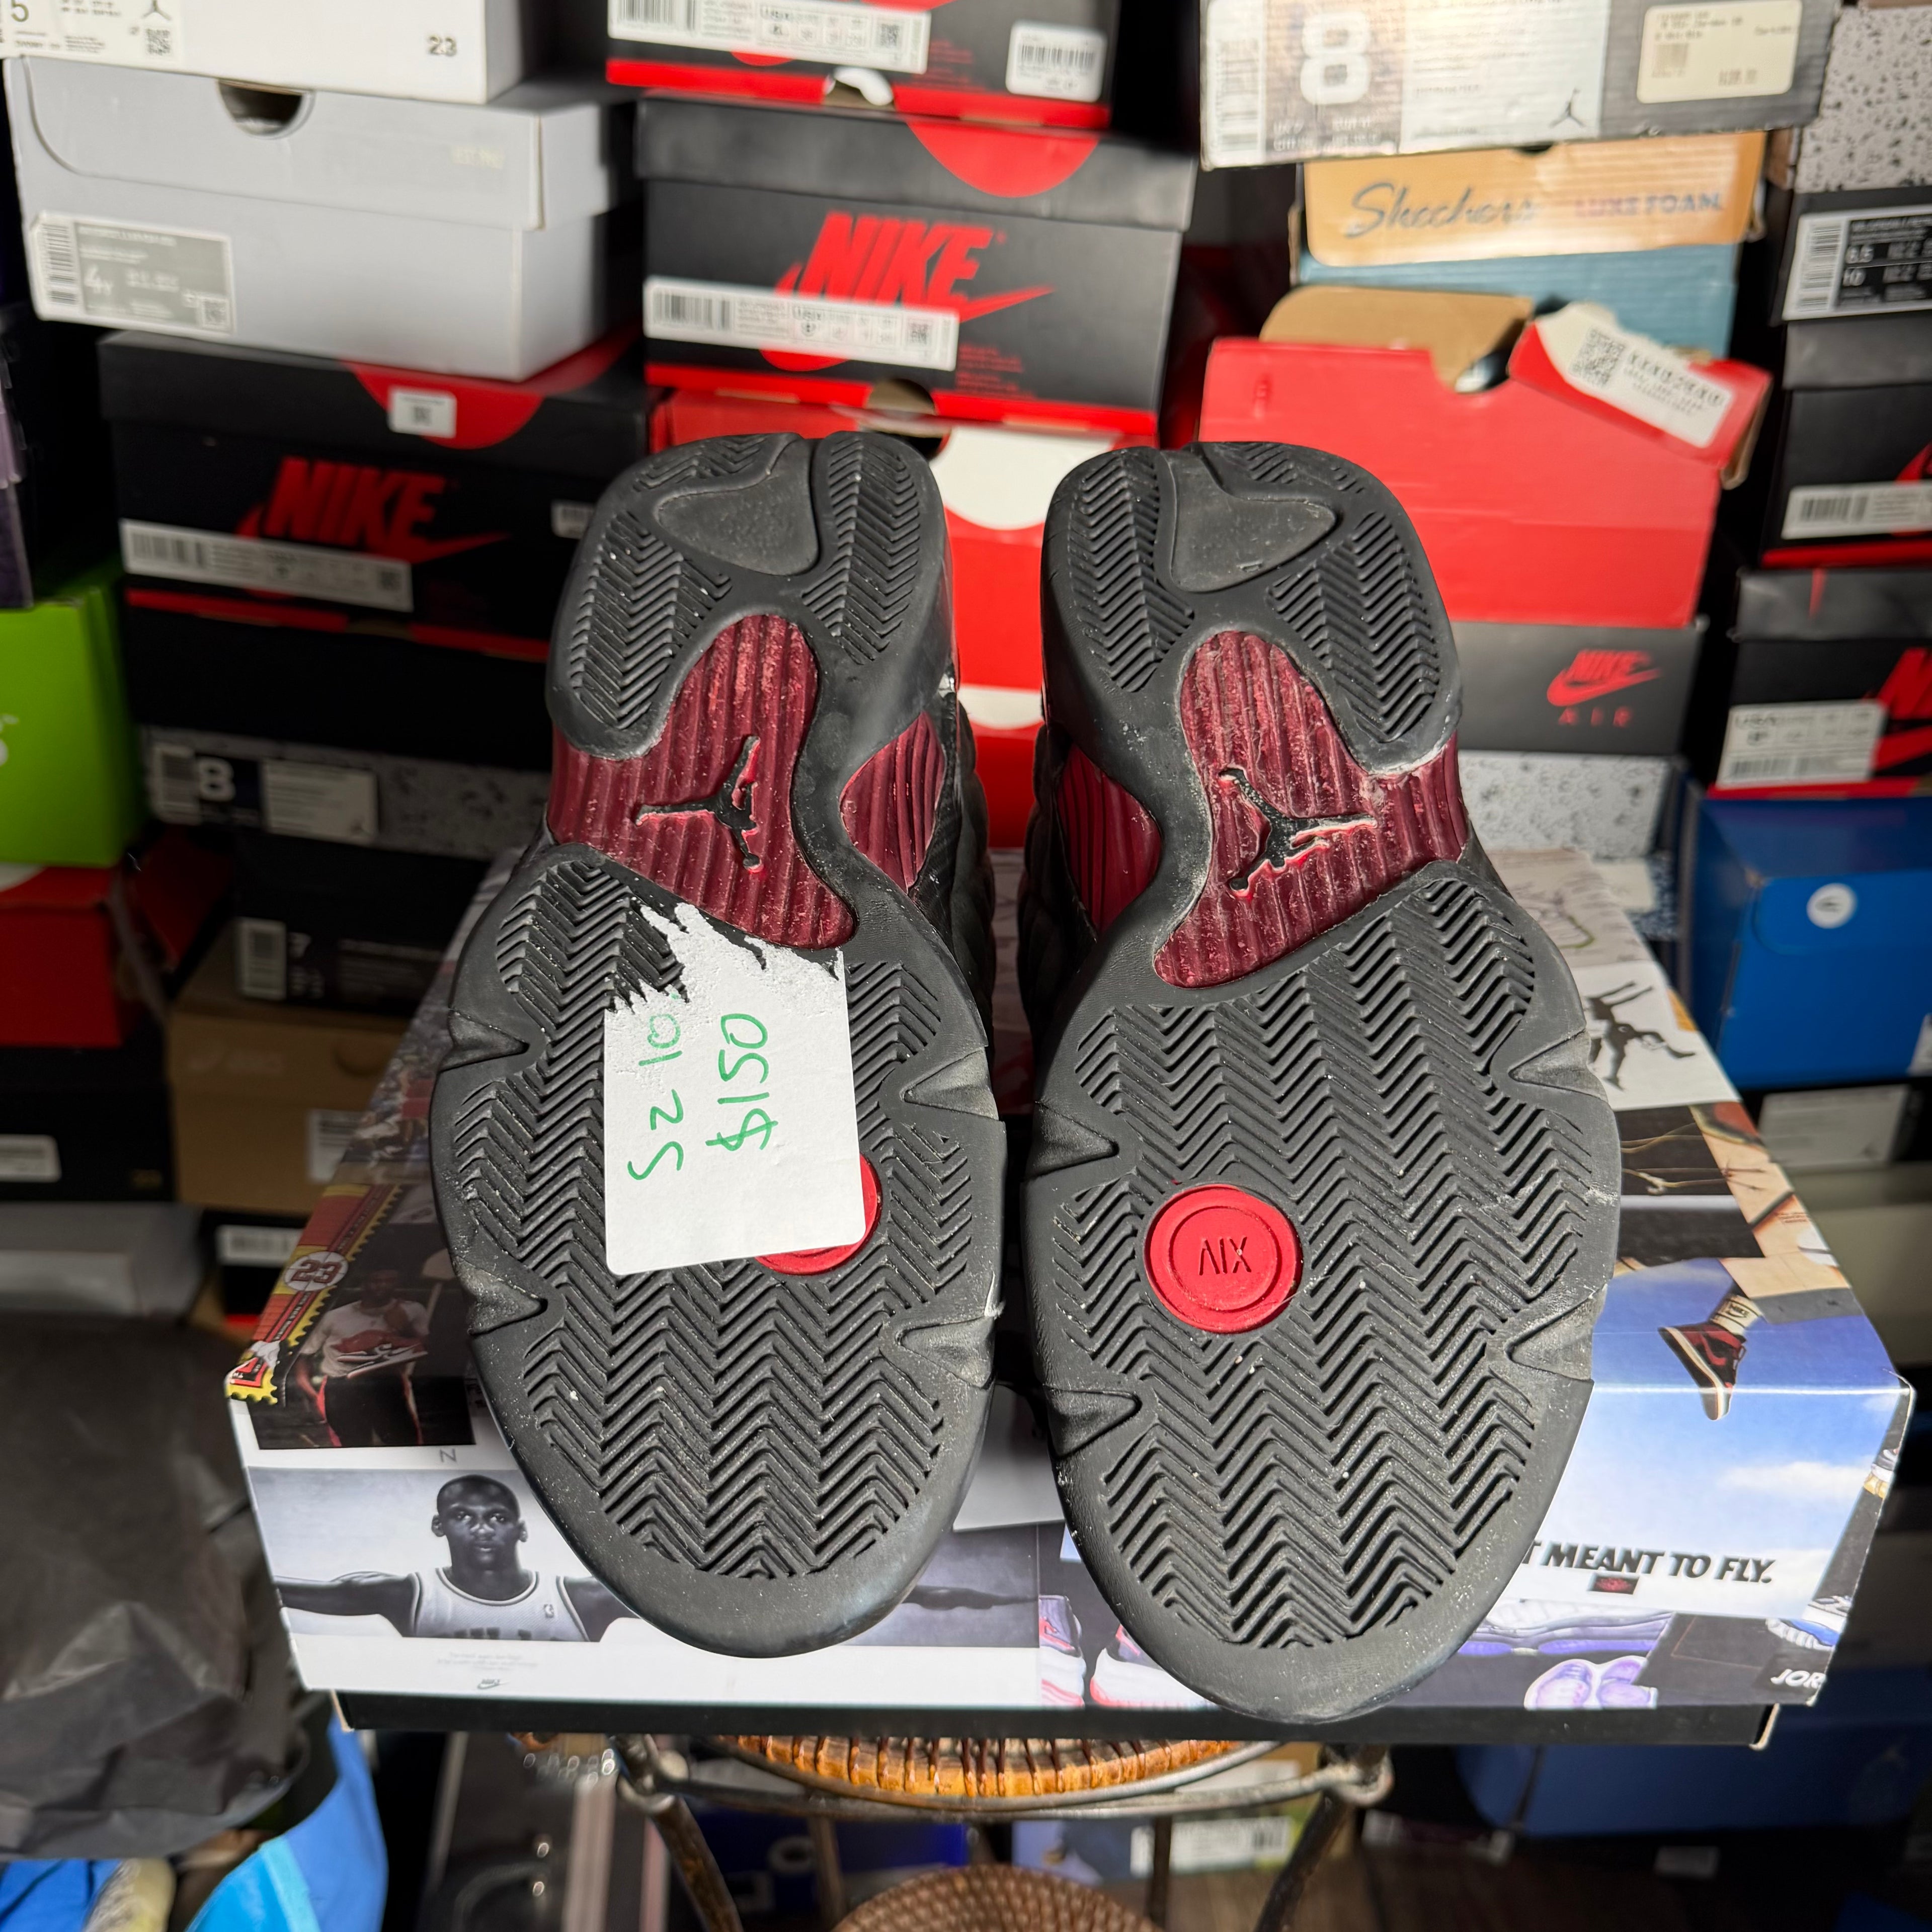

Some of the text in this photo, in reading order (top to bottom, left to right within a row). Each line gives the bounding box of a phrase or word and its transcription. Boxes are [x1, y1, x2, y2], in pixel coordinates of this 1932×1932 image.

[428, 36, 457, 56] 23
[1300, 11, 1371, 105] 8
[797, 211, 994, 310] NIKE
[262, 455, 448, 546] NIKE
[1564, 649, 1652, 682] NIKE
[1558, 706, 1633, 728] AIR
[705, 1013, 778, 1152] $150
[289, 1259, 342, 1284] 23
[1543, 1543, 1664, 1574] MEANT
[1669, 1552, 1711, 1578] TO
[1714, 1556, 1776, 1583] FLY.
